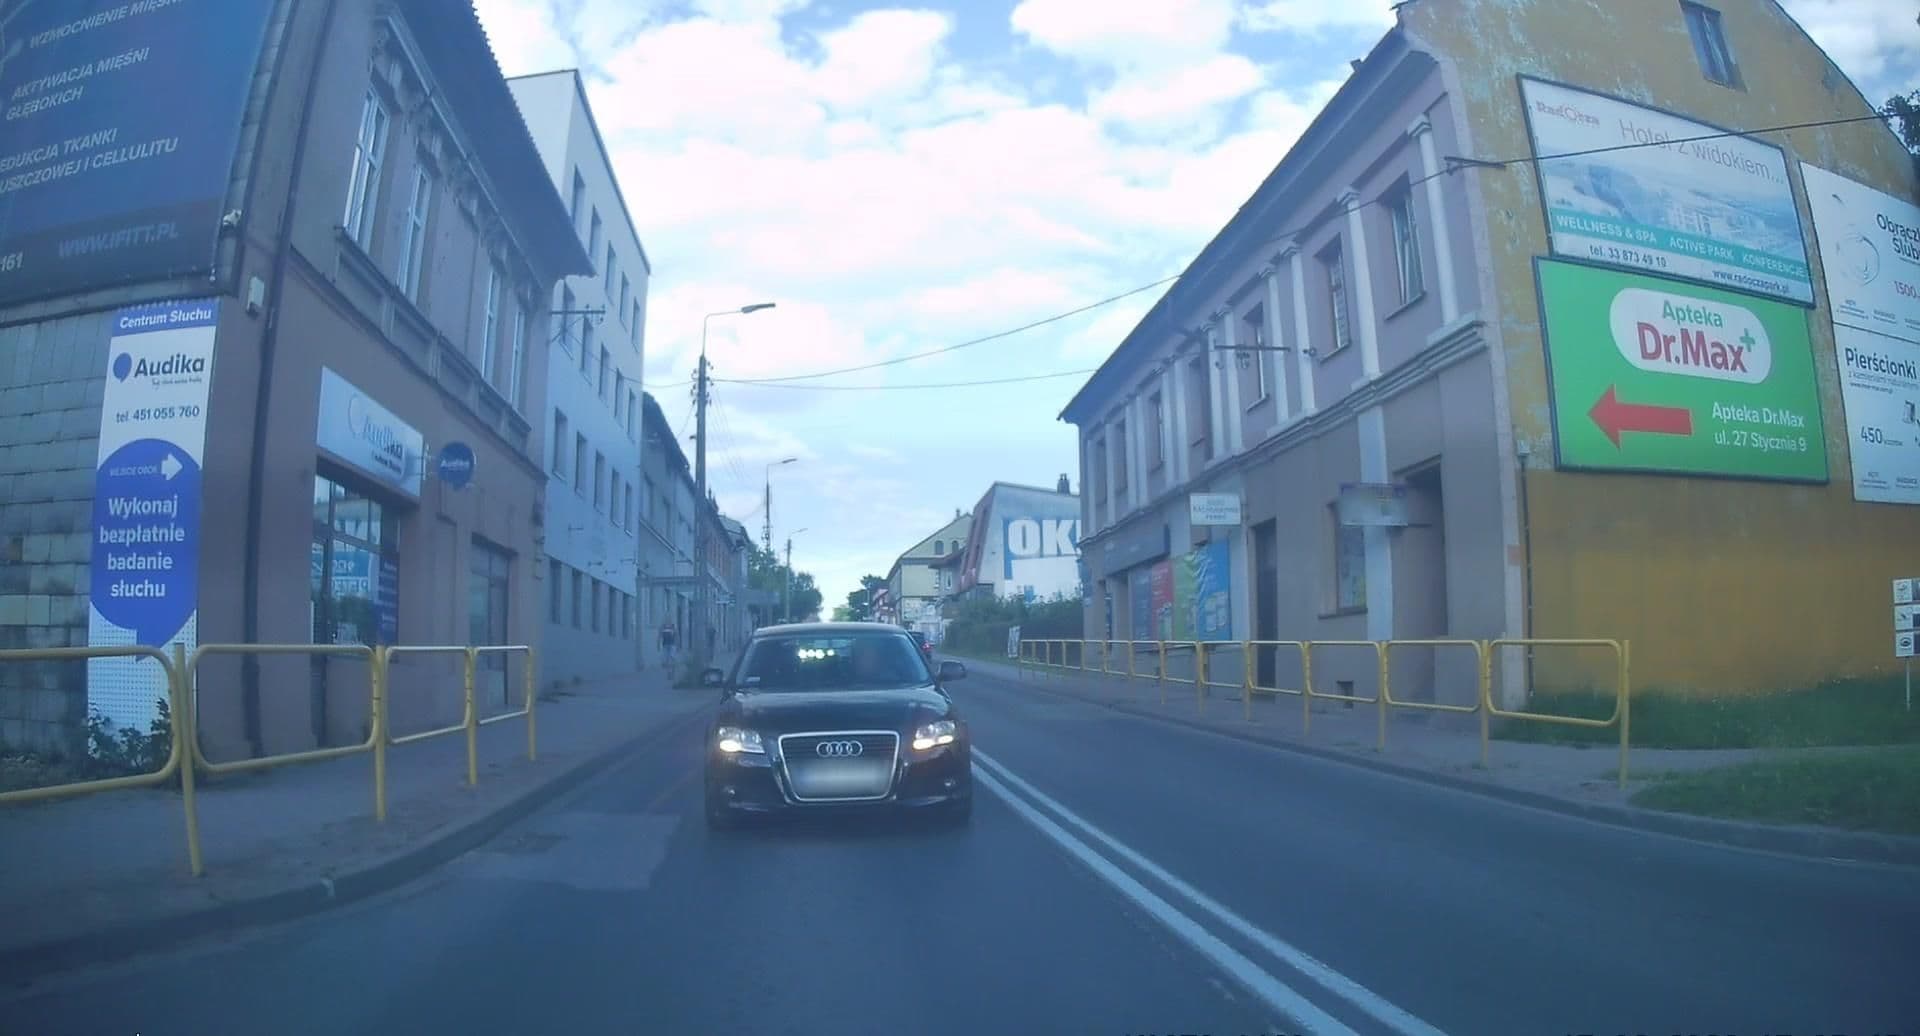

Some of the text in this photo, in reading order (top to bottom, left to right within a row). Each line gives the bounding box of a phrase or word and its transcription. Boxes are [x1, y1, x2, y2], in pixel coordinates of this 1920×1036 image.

[30, 5, 128, 48] WZMOCNIENIE
[12, 47, 150, 100] AKTYWACJA MIĘŚNI
[6, 86, 84, 121] GŁĘBOKICH
[63, 128, 118, 153] TKANKI
[1619, 119, 1672, 151] Hotel
[1691, 141, 1785, 184] widokiem...
[0, 137, 179, 193] USZCZOWEJ I CELLULITU
[59, 223, 179, 259] WWW.IFITT.PL
[1876, 213, 1920, 242] Obrącz
[1555, 214, 1808, 278] WELLNESS & SPA ACTIVE PARK KONFERENCJE
[1588, 244, 1606, 257] tel.
[1607, 246, 1621, 259] 33
[1622, 250, 1641, 265] 873
[1655, 256, 1668, 269] 10
[119, 314, 167, 329] Centrum
[1662, 299, 1724, 328] Apteka
[1637, 321, 1748, 374] Dr.Max
[134, 353, 206, 378] Audika
[1845, 347, 1918, 381] Pierścionki
[115, 410, 129, 424] tel
[132, 407, 151, 421] 451
[153, 406, 175, 420] 055
[1711, 401, 1805, 428] Apteka Dr.Max
[1713, 429, 1808, 454] ul. 27 Stycznia 9
[1860, 425, 1884, 445] 450
[107, 495, 178, 519] Wykonaj
[98, 522, 185, 547] bezpłatnie
[107, 551, 173, 571] badanie
[111, 579, 166, 598] słuchu
